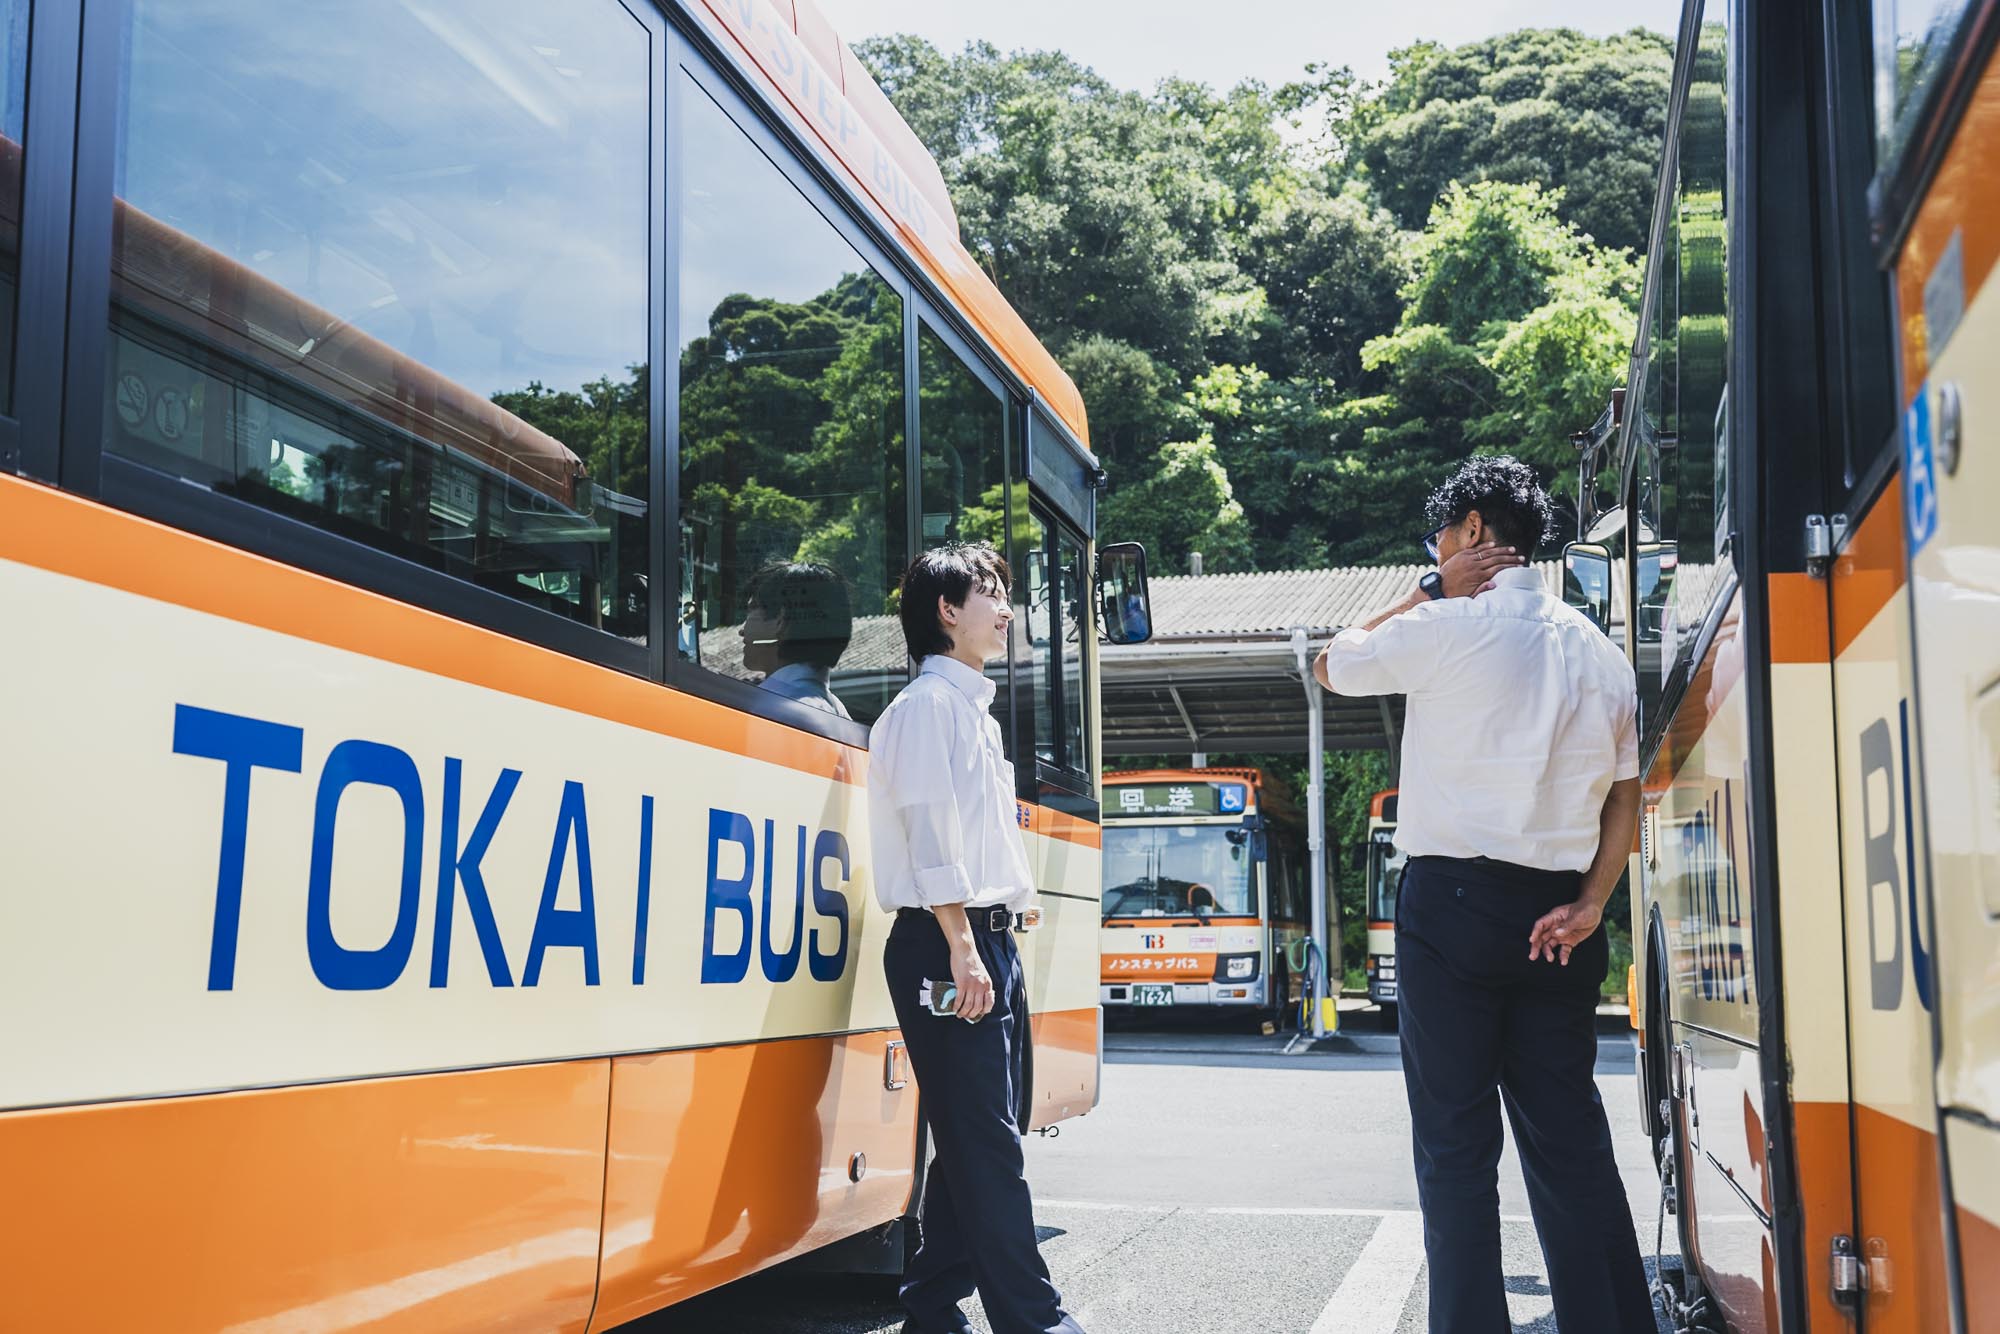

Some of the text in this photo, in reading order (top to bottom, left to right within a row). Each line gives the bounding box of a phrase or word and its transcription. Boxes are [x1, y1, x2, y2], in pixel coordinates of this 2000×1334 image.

[872, 144, 928, 236] BUS
[173, 703, 850, 991] TOKAI BUS
[1109, 957, 1199, 971] ノンステップバス
